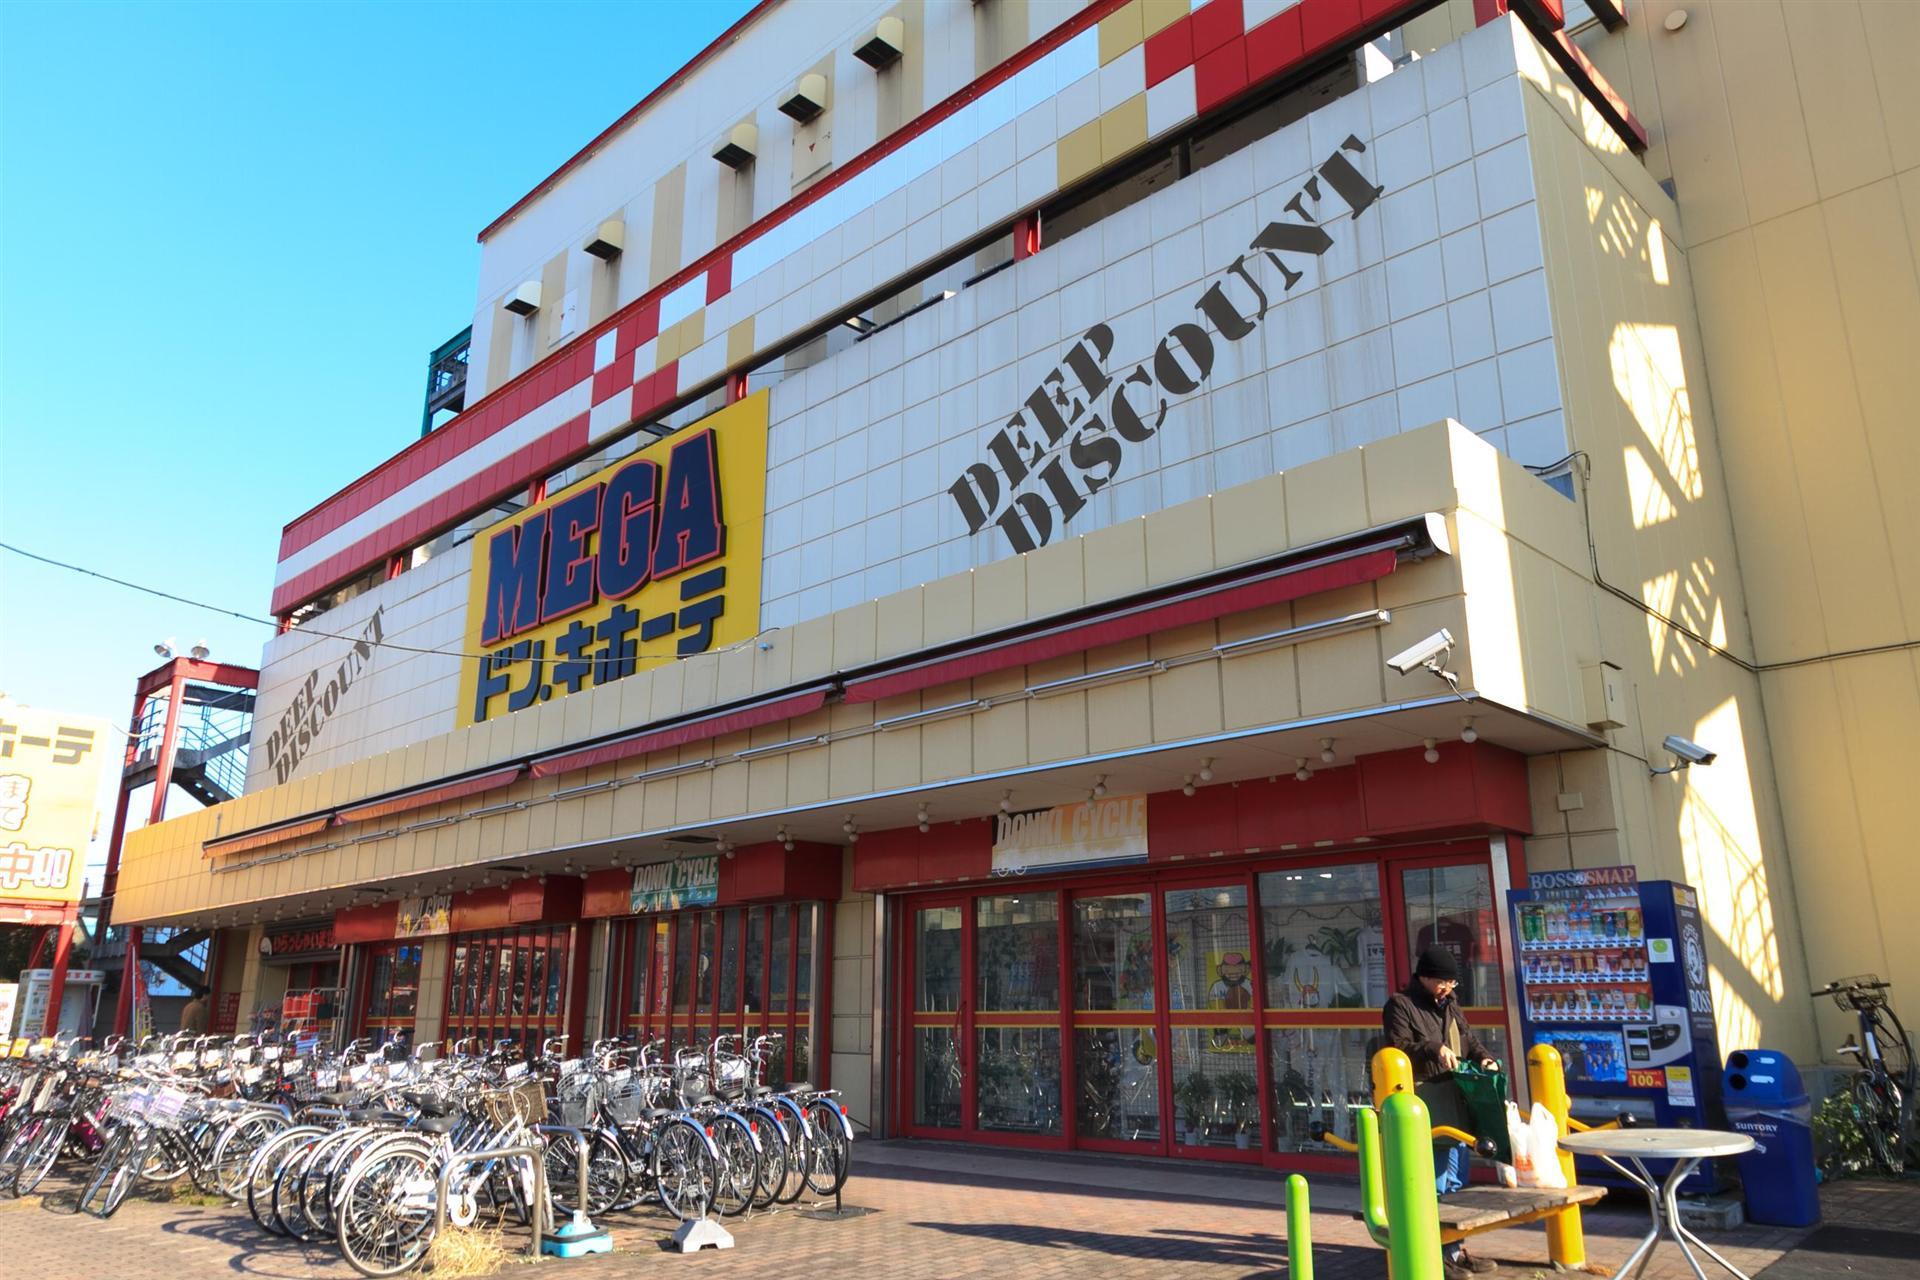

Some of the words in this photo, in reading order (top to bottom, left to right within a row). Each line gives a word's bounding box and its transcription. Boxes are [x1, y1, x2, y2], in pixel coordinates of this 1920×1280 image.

[996, 133, 1386, 554] DISCOUNT
[947, 322, 1115, 536] DEEP
[480, 427, 727, 648] MEGA
[264, 669, 319, 770] DEEP
[275, 604, 386, 785] DISCOUNT
[994, 808, 1064, 850] DONKI
[1072, 797, 1145, 843] CYCLE
[633, 862, 673, 893] DONKI
[675, 856, 719, 889] CYCLE
[1529, 872, 1579, 890] BOSS
[1585, 868, 1634, 887] SMAP
[1688, 989, 1713, 1013] BOSS
